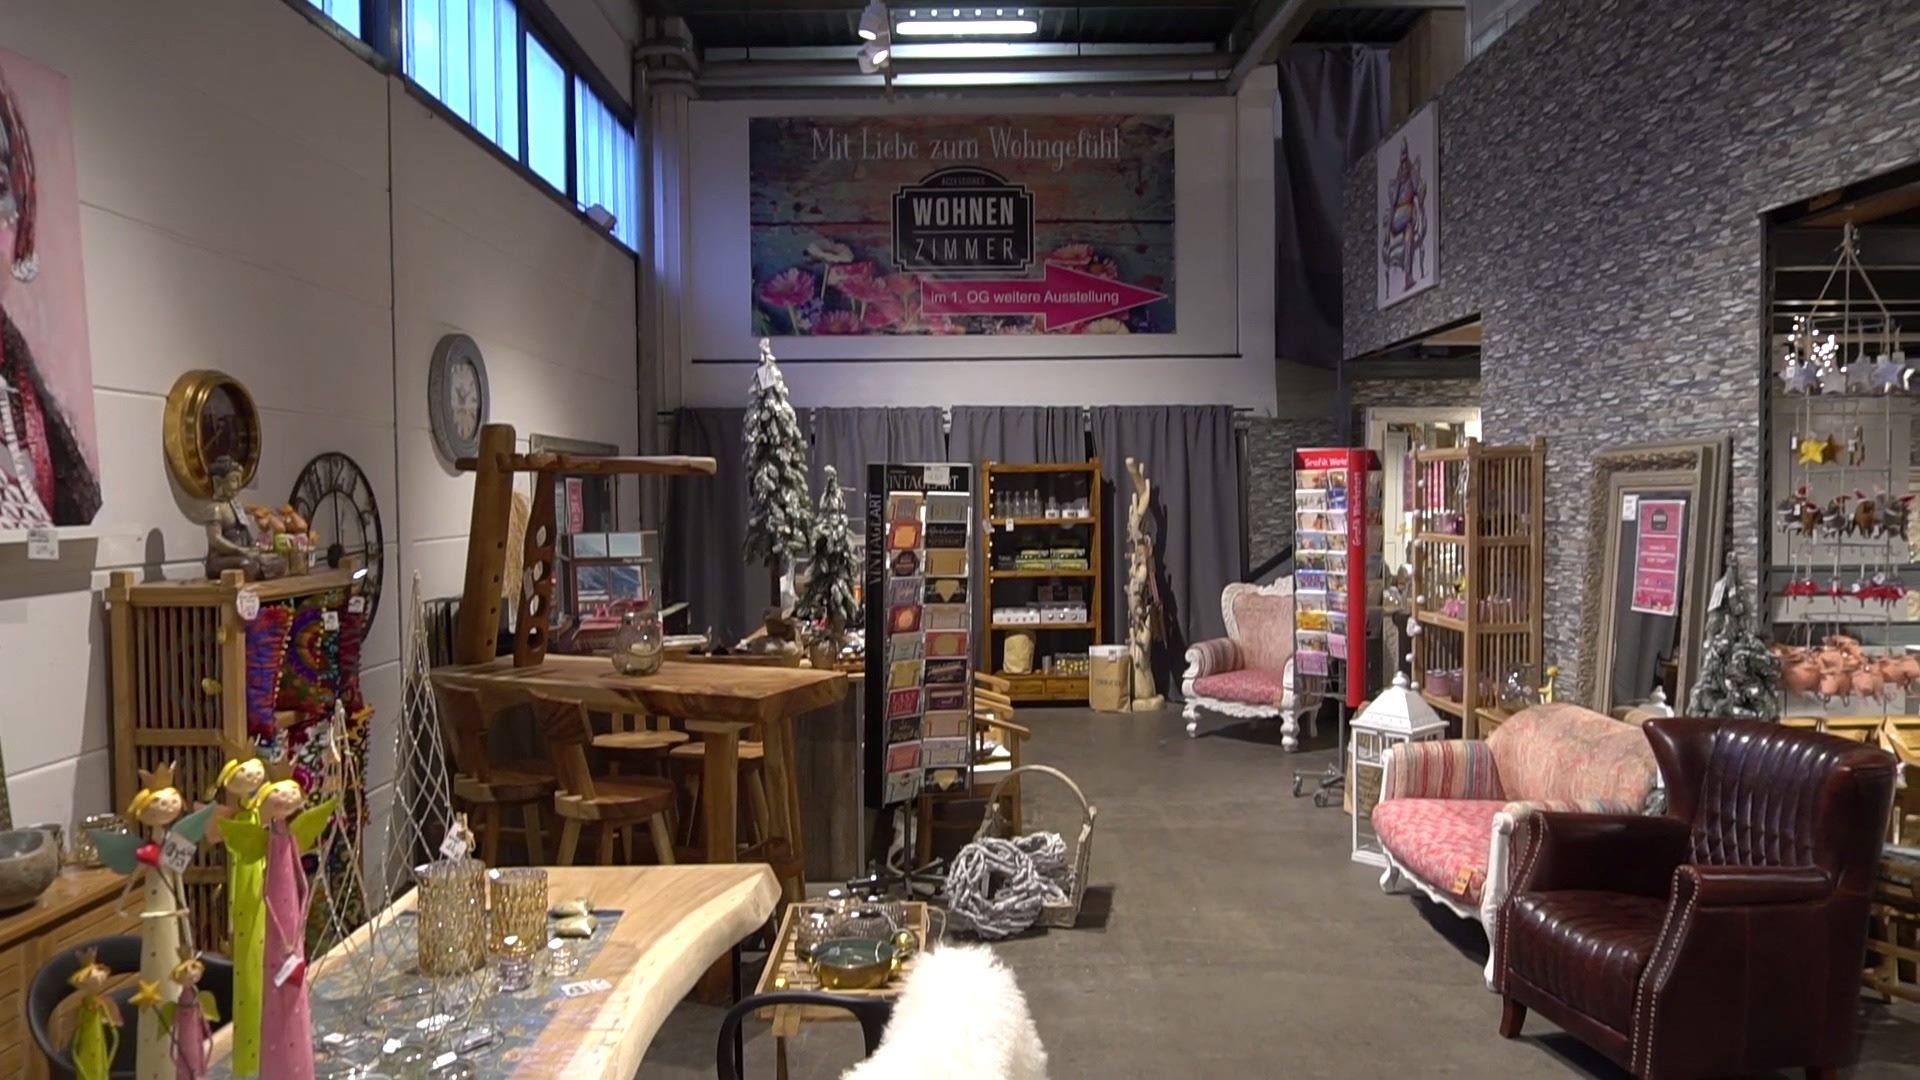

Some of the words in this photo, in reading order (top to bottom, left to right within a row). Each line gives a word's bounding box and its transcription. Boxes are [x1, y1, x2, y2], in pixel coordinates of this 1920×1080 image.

[811, 127, 850, 160] Mit
[862, 127, 919, 160] Liebe
[929, 138, 978, 160] zum
[987, 126, 1119, 172] Wohngefühl
[912, 197, 1014, 226] WOHNEN
[914, 237, 1013, 260] ZIMMER
[951, 291, 963, 304] 1.
[967, 290, 990, 304] OG
[994, 291, 1041, 304] weitere
[1043, 290, 1120, 307] Ausstellung
